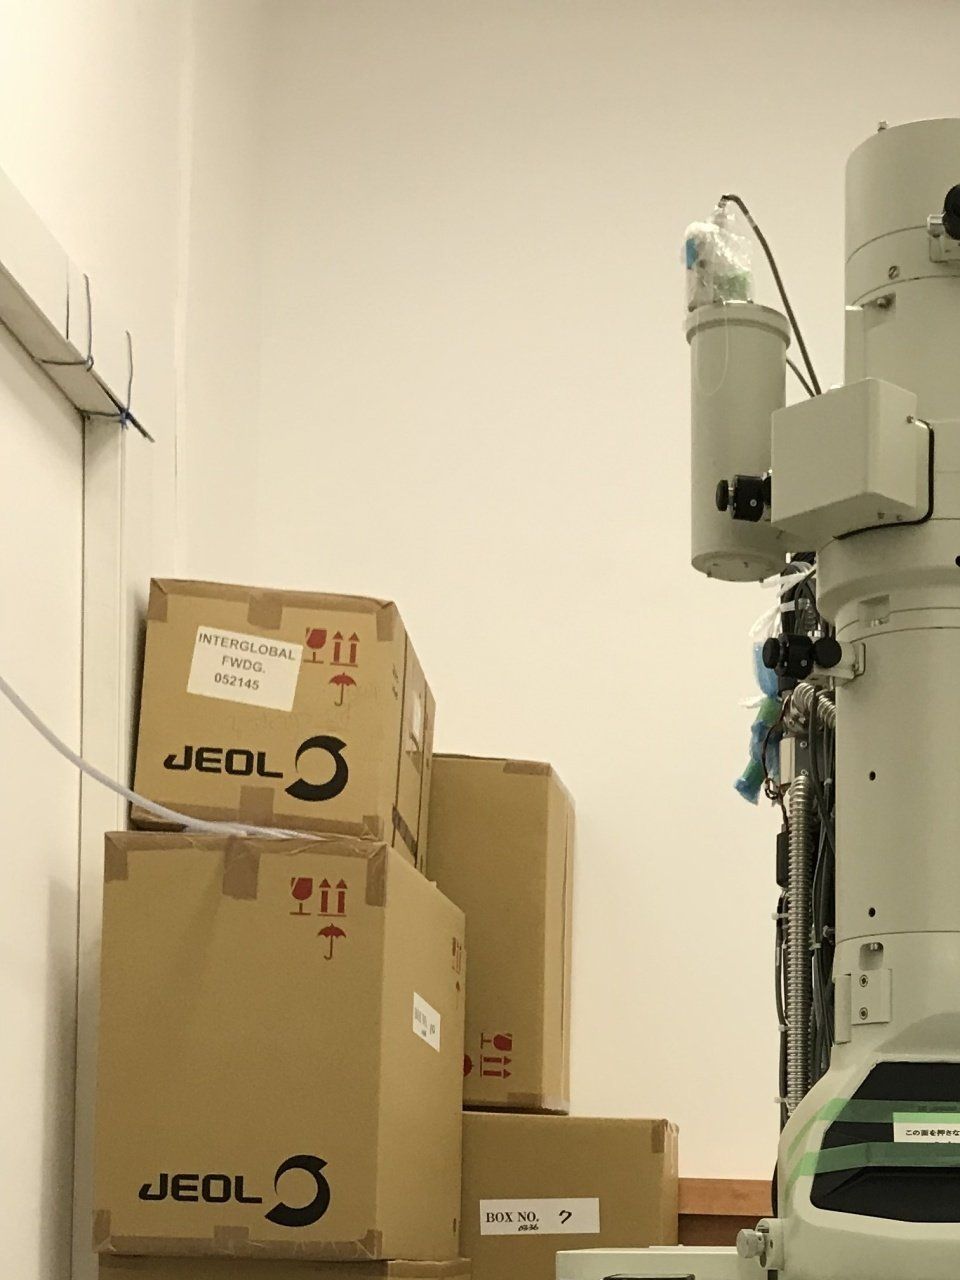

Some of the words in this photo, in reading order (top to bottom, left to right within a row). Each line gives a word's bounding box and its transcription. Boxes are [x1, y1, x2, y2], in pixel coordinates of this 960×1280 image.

[198, 633, 296, 661] INTERGLOBAL
[222, 655, 266, 674] FWDG.
[214, 672, 260, 690] 052145
[163, 745, 283, 778] JEOL
[138, 1173, 262, 1204] JEOL
[486, 1212, 513, 1223] BOX
[518, 1211, 540, 1223] NO.
